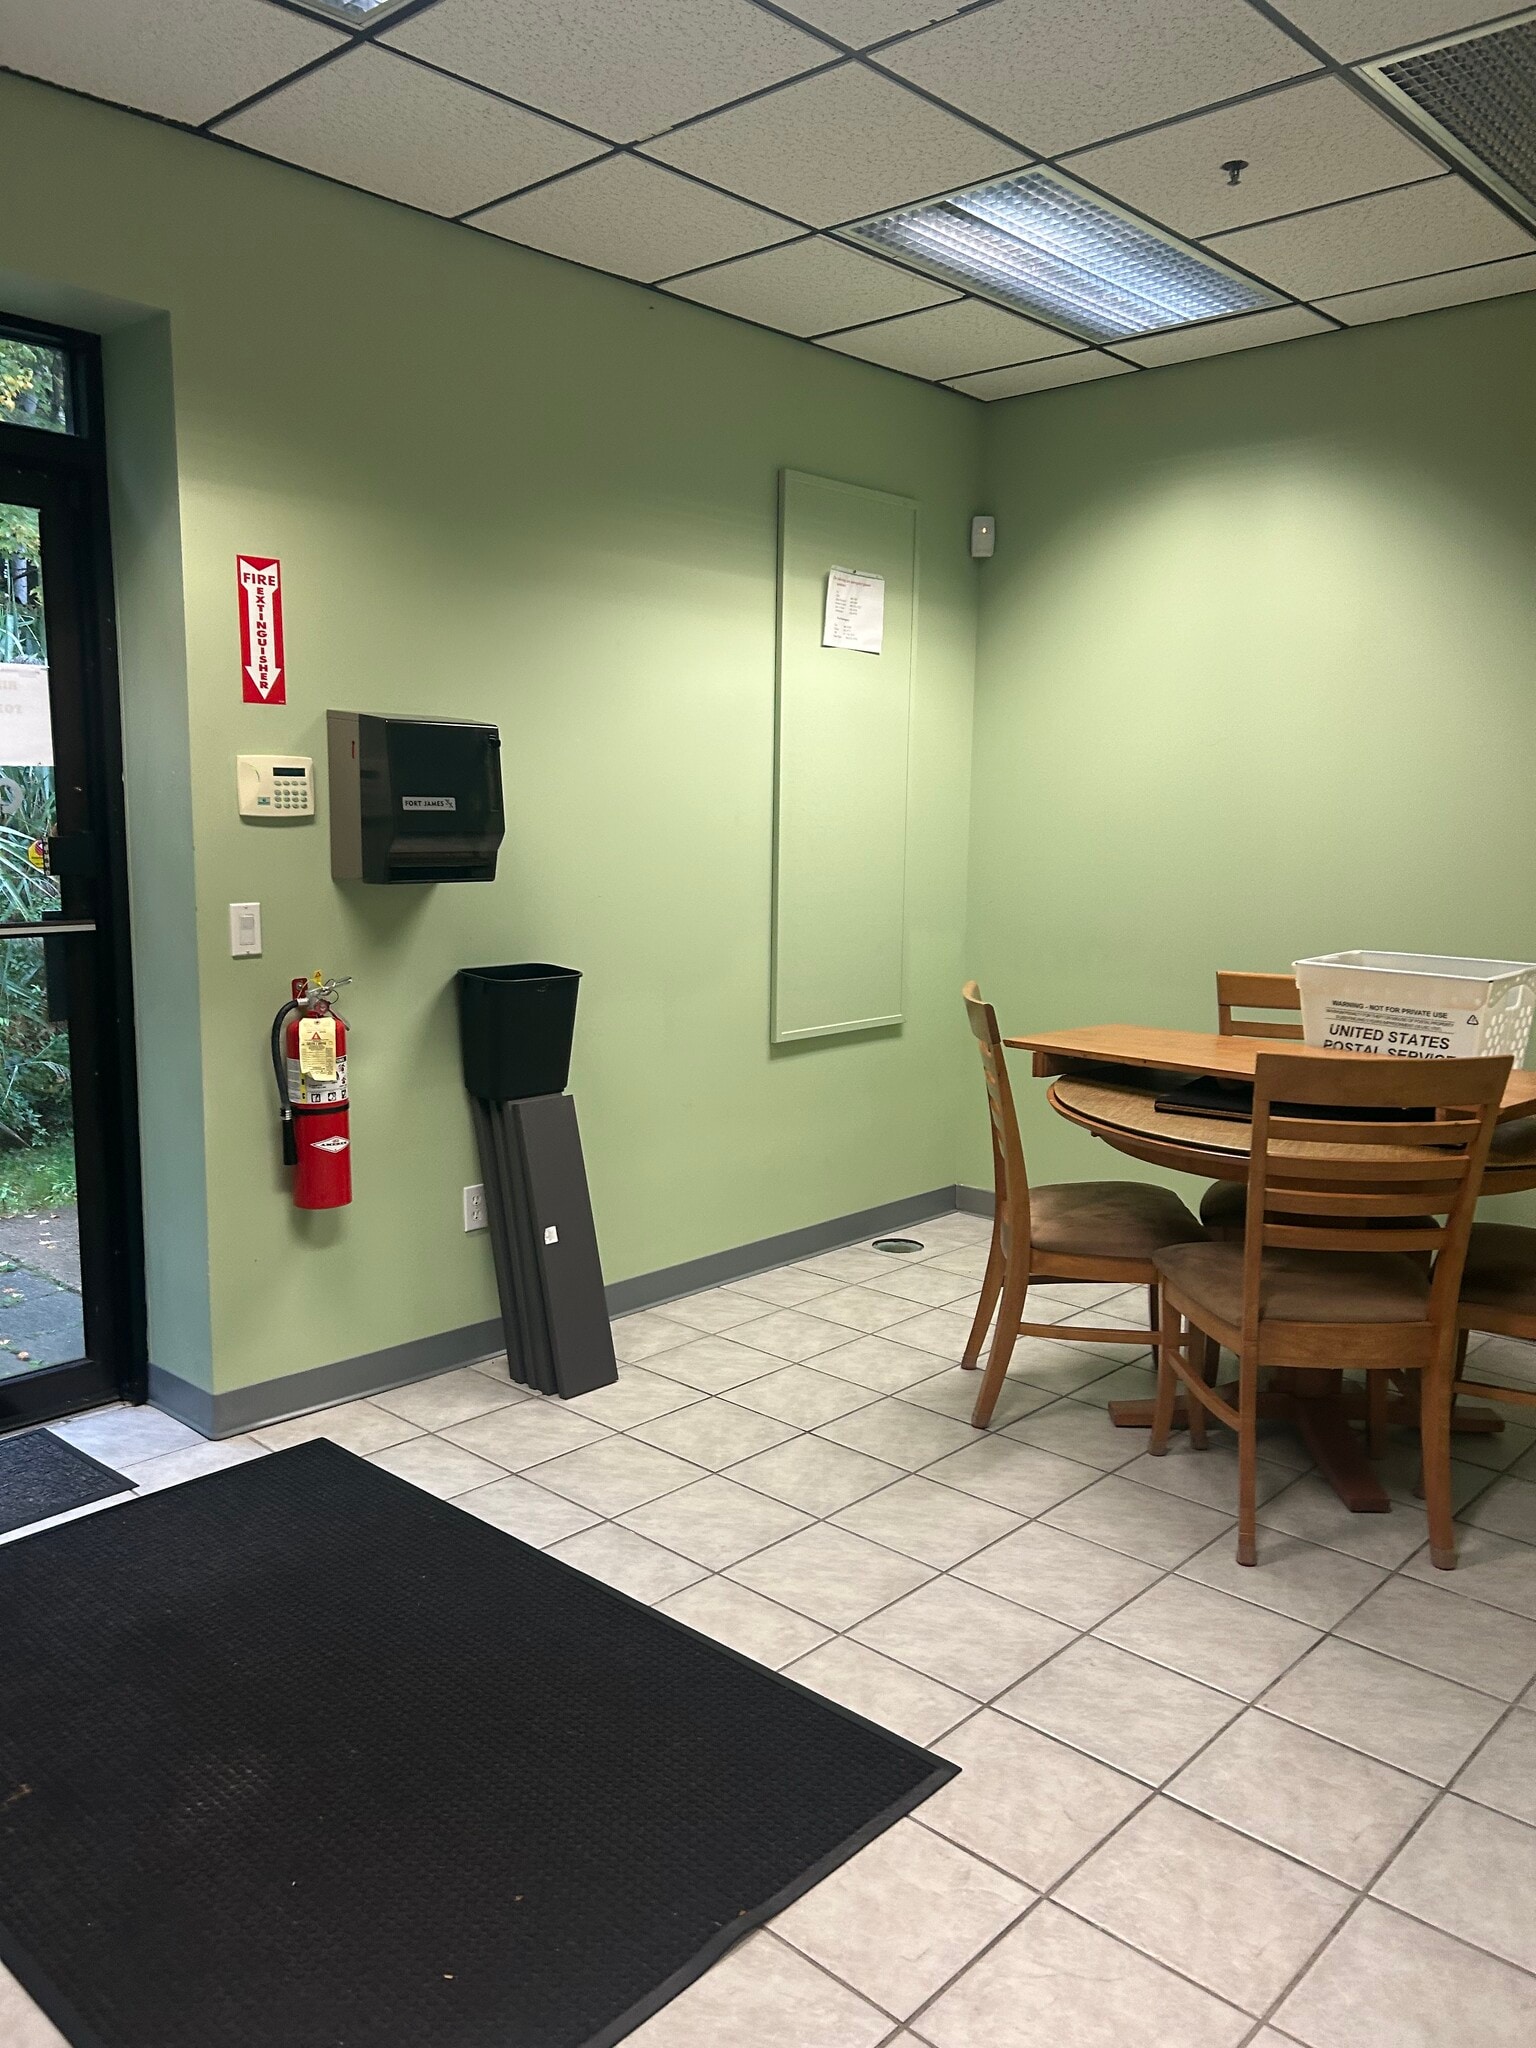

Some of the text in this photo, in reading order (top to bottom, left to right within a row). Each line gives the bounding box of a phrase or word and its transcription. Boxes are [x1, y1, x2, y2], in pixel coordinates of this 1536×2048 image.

[243, 572, 275, 586] FIRE
[255, 587, 269, 689] EXTINGUISHER
[1332, 1000, 1364, 1010] WARNING
[1385, 1006, 1401, 1014] FOR
[1401, 1008, 1431, 1017] PRIVATE
[1329, 1023, 1384, 1041] UNITED
[1388, 1031, 1450, 1050] STATES
